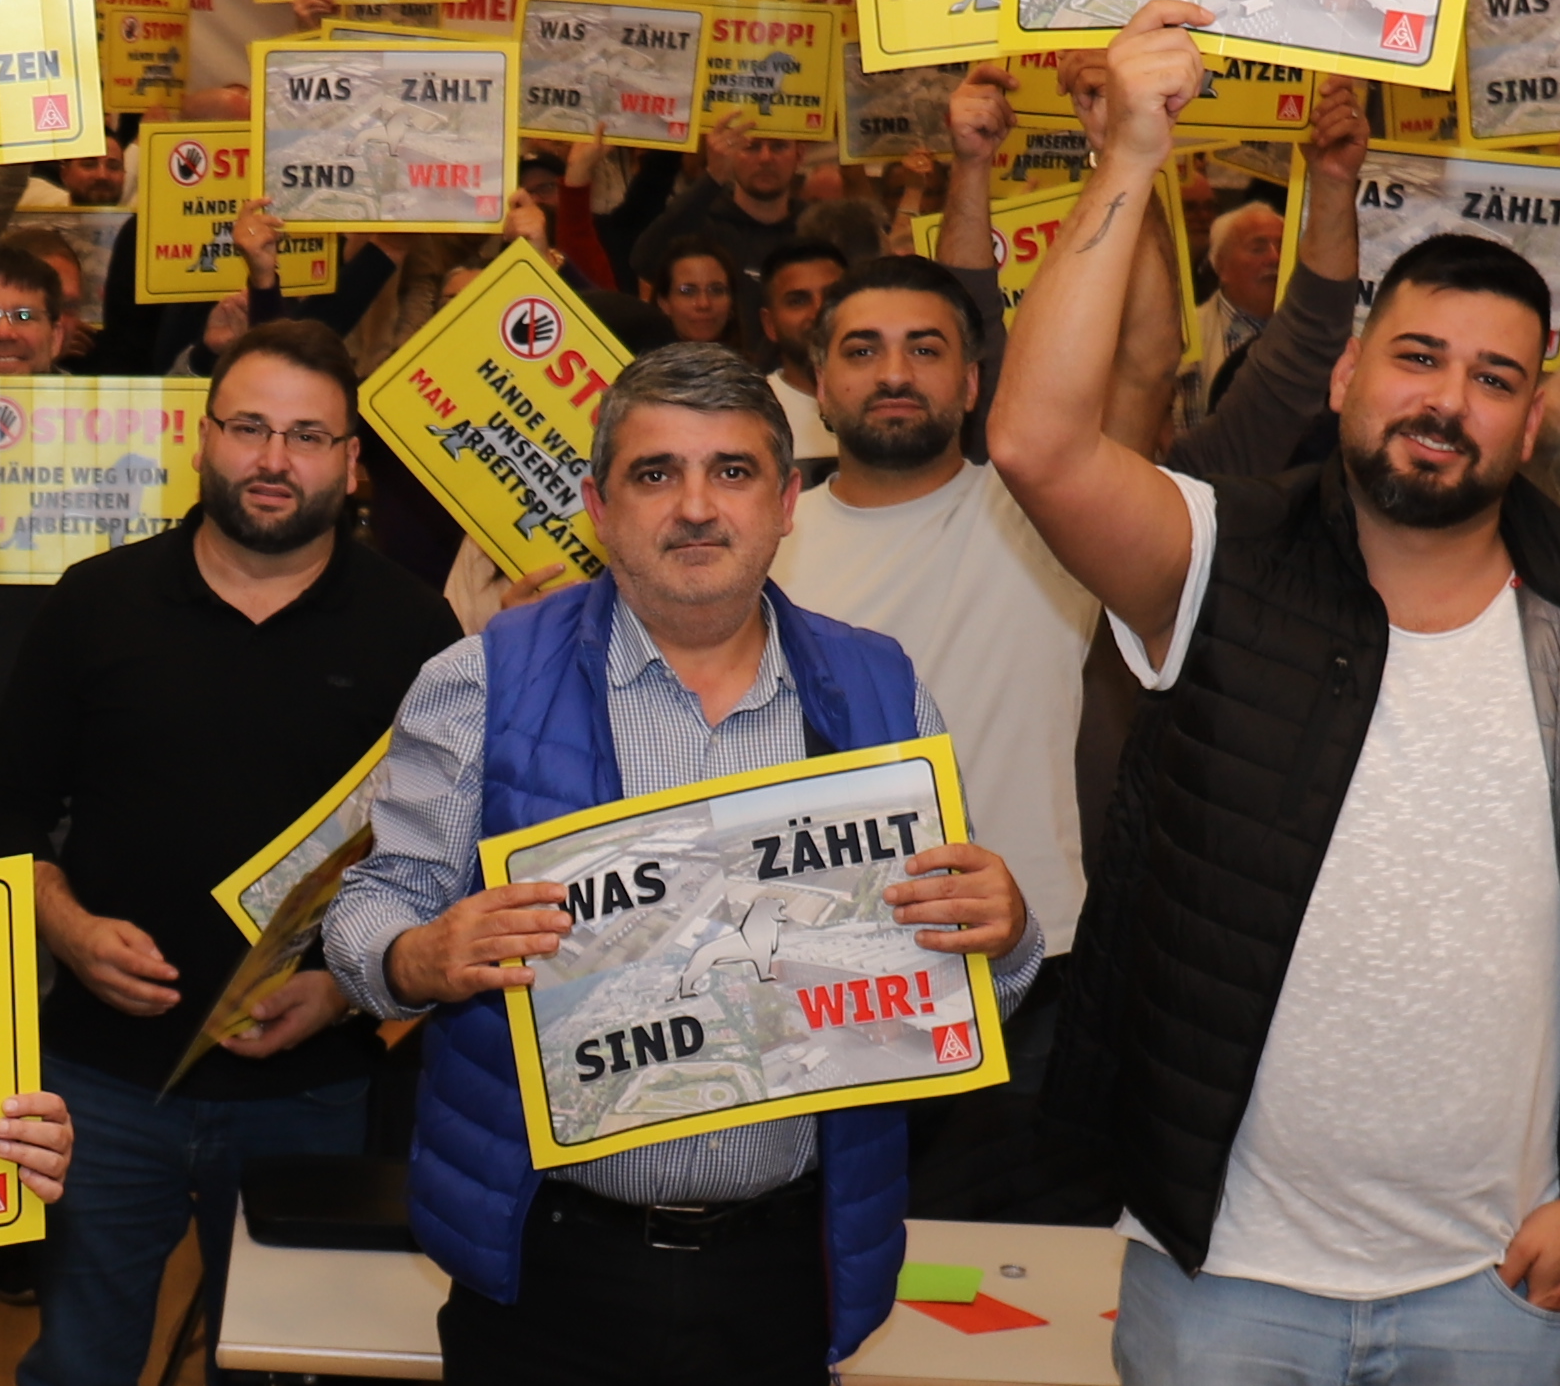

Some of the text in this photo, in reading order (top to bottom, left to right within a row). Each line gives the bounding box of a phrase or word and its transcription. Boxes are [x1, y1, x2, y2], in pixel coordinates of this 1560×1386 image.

[540, 21, 691, 51] WAS ZÄHLT
[713, 18, 815, 47] STOPP!
[287, 72, 493, 103] WAS ZÄHLT
[527, 86, 678, 117] SIND WIR!
[1486, 77, 1559, 105] SIND
[282, 164, 483, 188] SIND WIR!
[182, 196, 237, 215] HÄNDE
[155, 243, 193, 260] MAN
[408, 367, 457, 420] MAN
[32, 407, 185, 444] STOPP!
[476, 358, 545, 433] HÄNDE
[540, 424, 590, 477] WEG
[487, 410, 578, 507] UNSEREN
[71, 467, 117, 485] WEG
[126, 467, 169, 486] VON
[29, 492, 130, 510] UNSEREN
[560, 811, 920, 927] WAS ZÄHLT
[574, 970, 936, 1083] SIND WIR!
